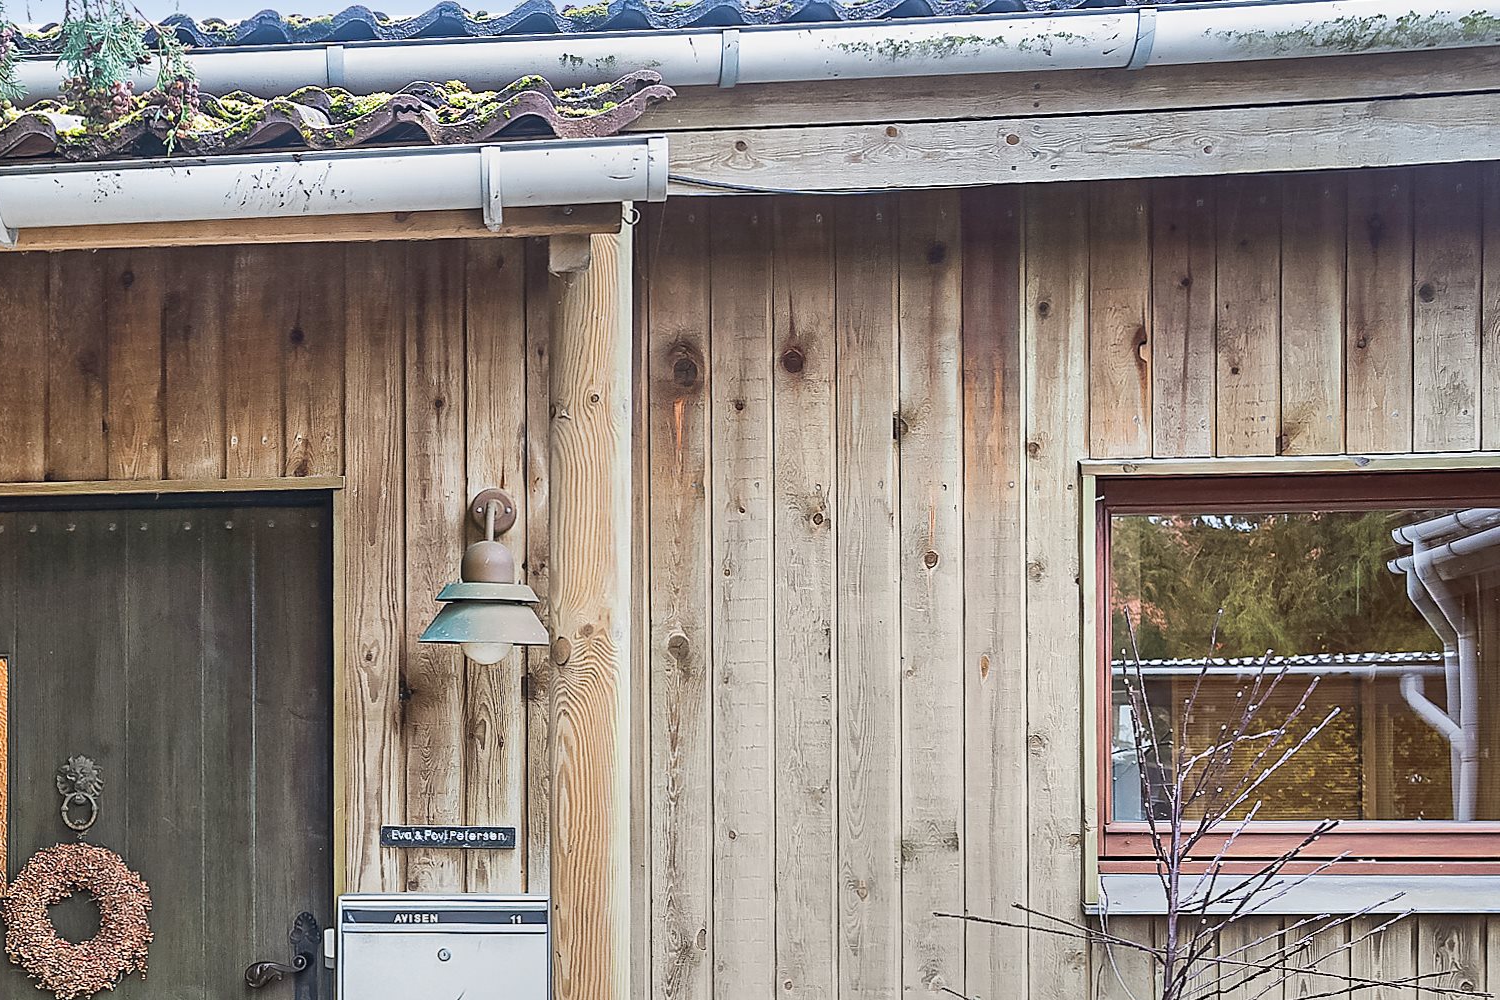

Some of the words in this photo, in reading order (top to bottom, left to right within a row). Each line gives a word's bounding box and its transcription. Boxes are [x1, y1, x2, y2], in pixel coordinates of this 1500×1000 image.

[391, 829, 412, 840] Eva
[414, 830, 423, 841] &
[449, 829, 505, 841] Petersen
[393, 913, 439, 923] AVISEN
[510, 914, 522, 924] 11
